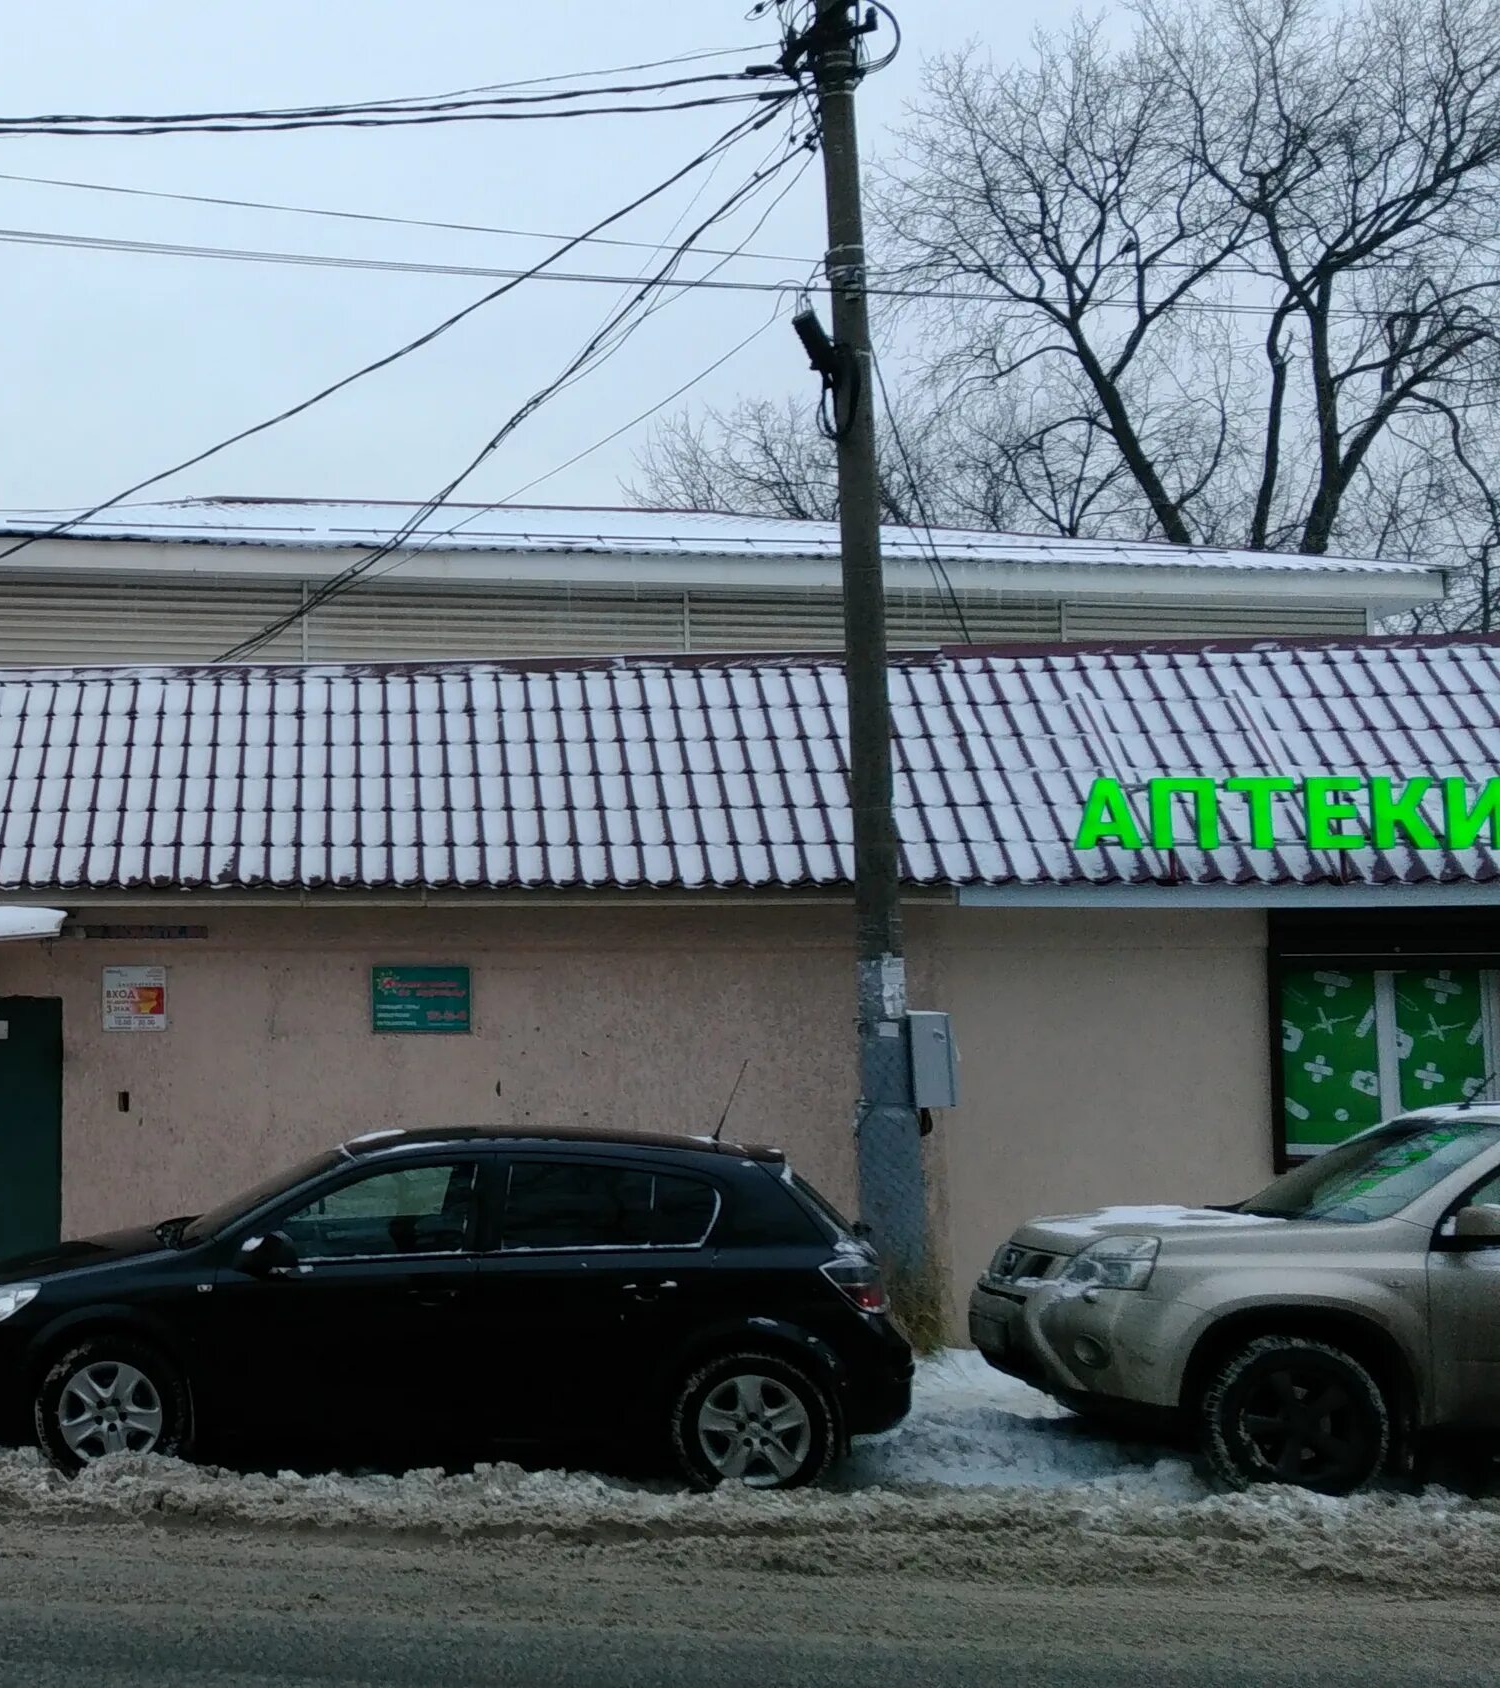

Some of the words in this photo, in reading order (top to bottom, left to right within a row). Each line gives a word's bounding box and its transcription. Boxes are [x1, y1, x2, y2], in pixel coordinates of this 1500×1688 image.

[1073, 776, 1500, 850] АПТЕКИ
[106, 989, 136, 999] ВХОД
[106, 1004, 112, 1014] 3
